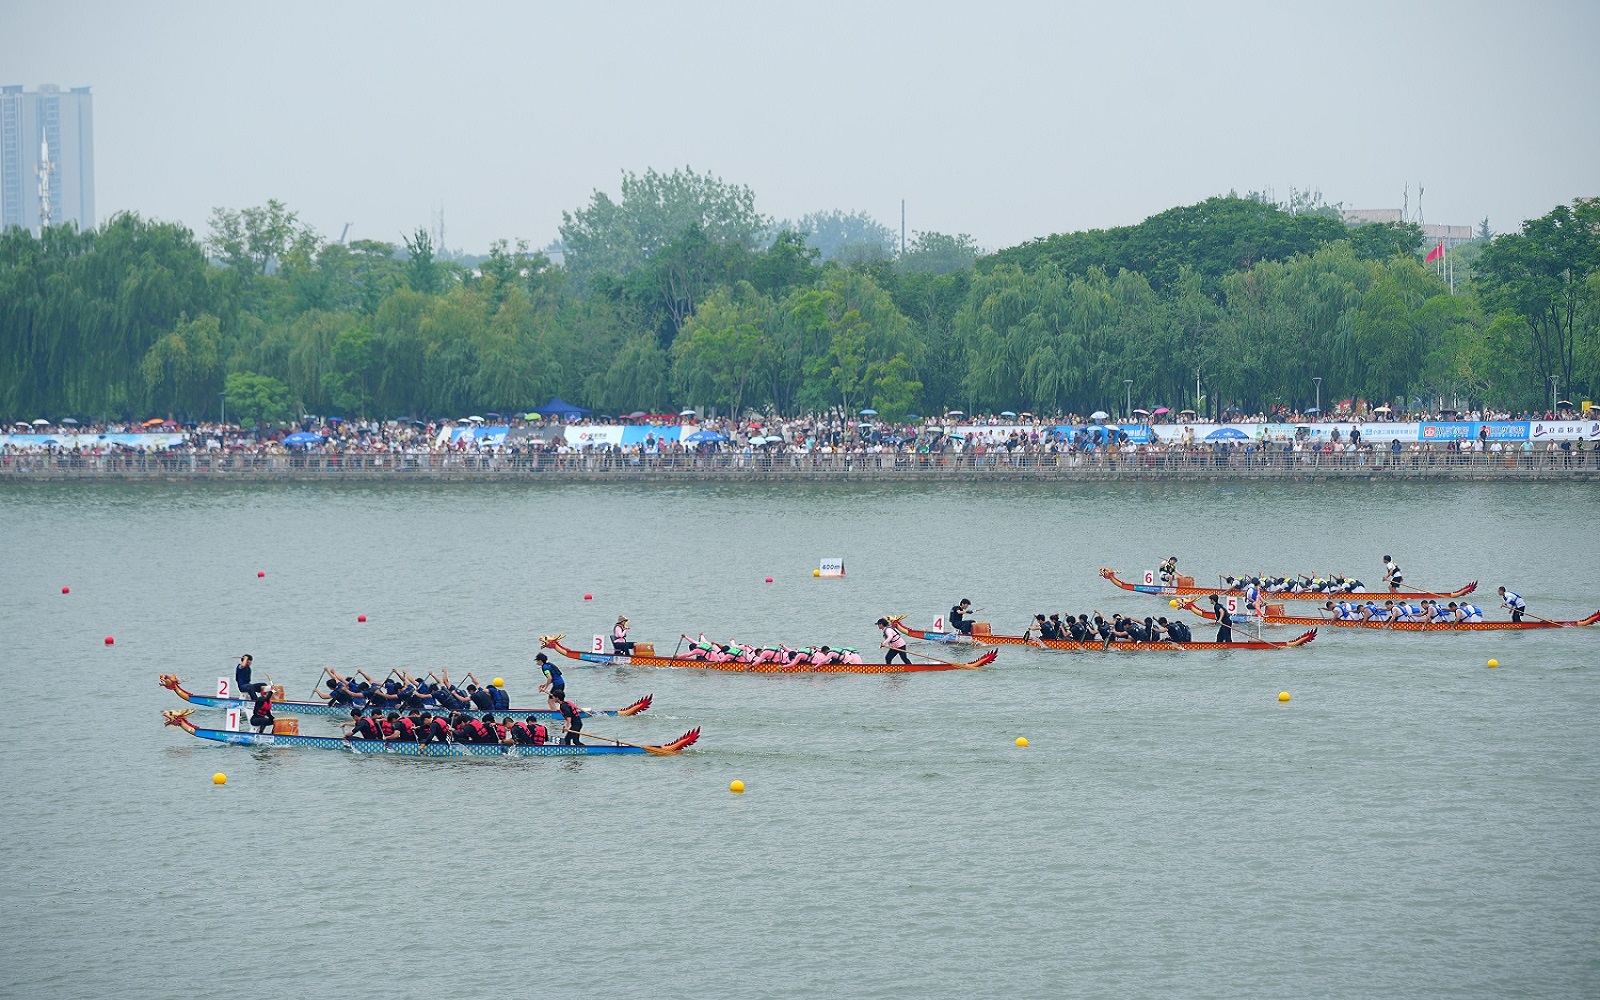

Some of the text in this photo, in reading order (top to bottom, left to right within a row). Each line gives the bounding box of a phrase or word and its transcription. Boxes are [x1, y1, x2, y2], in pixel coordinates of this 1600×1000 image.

[1145, 573, 1152, 584] 6
[1228, 599, 1236, 611] 5
[934, 618, 943, 630] 4
[594, 637, 603, 651] 3
[219, 680, 228, 695] 2
[229, 713, 236, 728] 1
